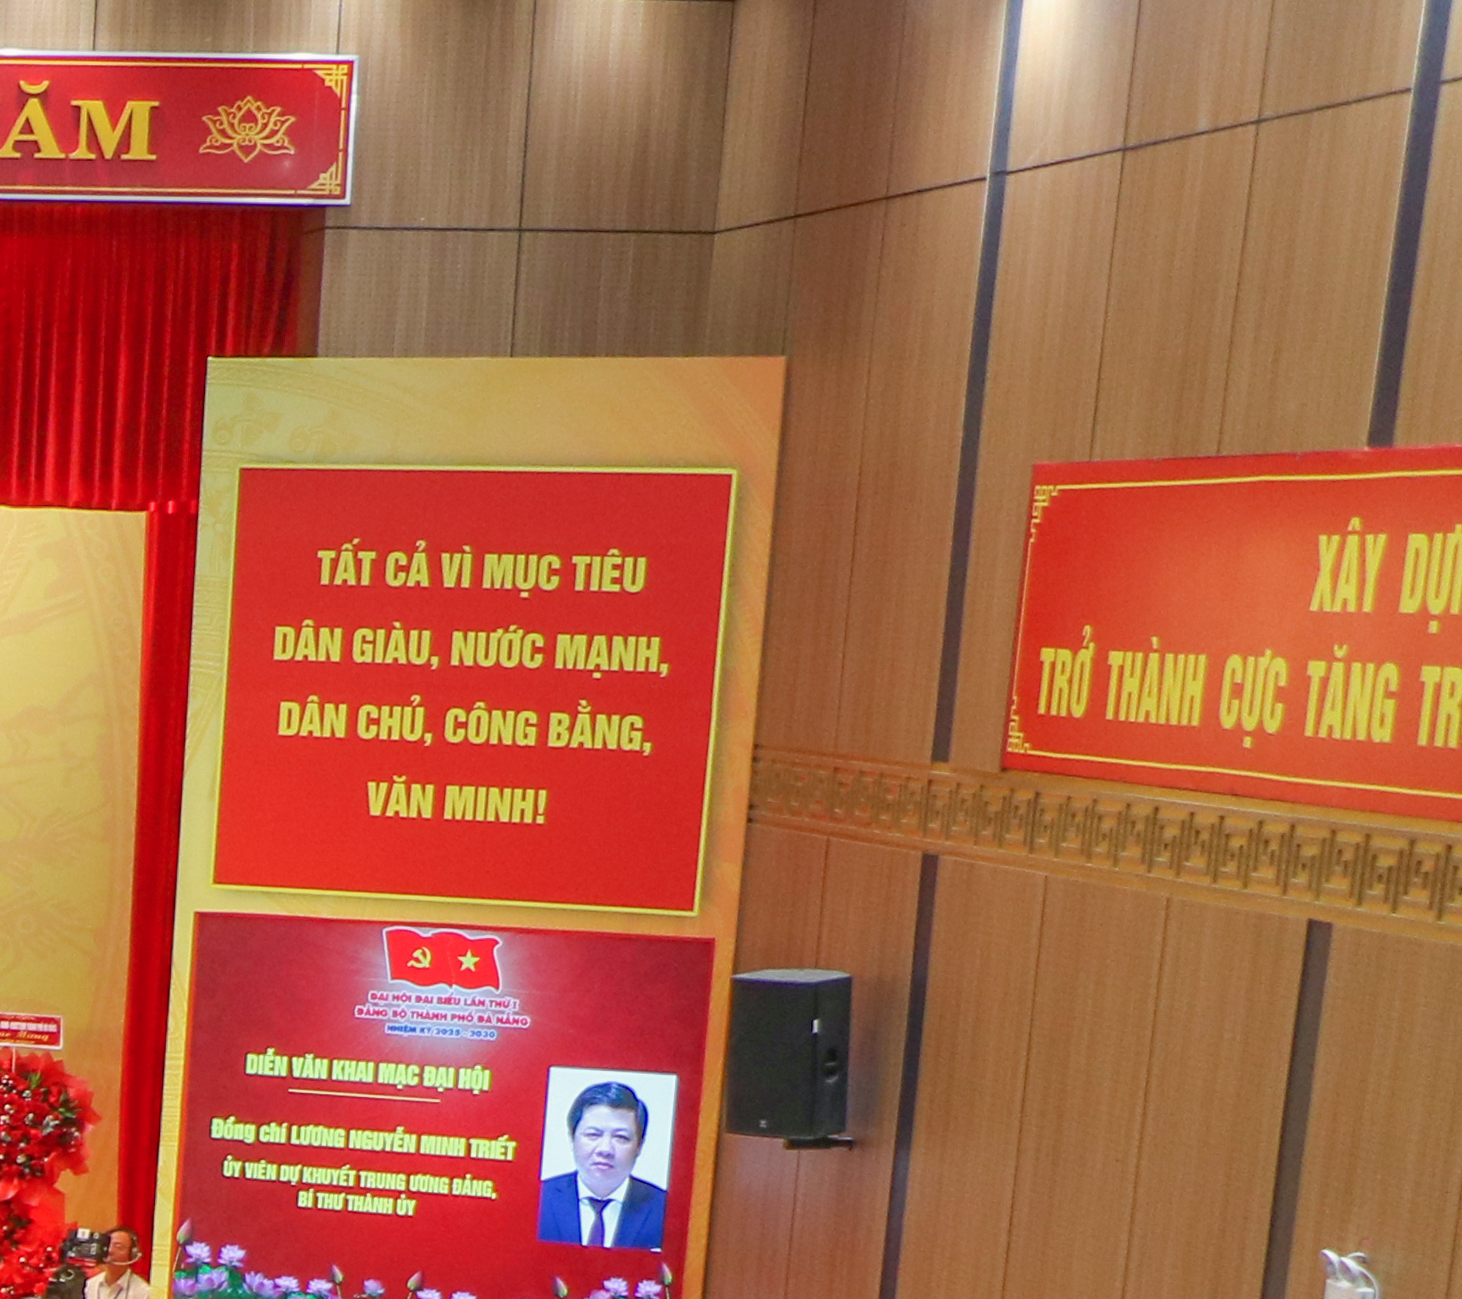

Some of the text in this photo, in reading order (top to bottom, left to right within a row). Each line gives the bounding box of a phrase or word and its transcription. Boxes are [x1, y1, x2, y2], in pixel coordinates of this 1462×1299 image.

[318, 538, 647, 597] TẤT CẢ VÌ MỤC TIÊU
[1309, 517, 1388, 613] XÂY
[274, 619, 669, 678] DÂN GIÀU, NƯỚC MẠNH,
[1039, 625, 1095, 717] TRỞ
[1106, 637, 1208, 726] THÀNH
[1220, 648, 1289, 748] CỰC
[1305, 644, 1400, 742] TĂNG
[278, 695, 652, 755] DÂN CHỦ, CÔNG BẰNG,
[368, 776, 547, 824] VĂN MINH!
[246, 1049, 288, 1077] DIỄN
[292, 1053, 327, 1079] VĂN
[332, 1058, 373, 1082] KHAI
